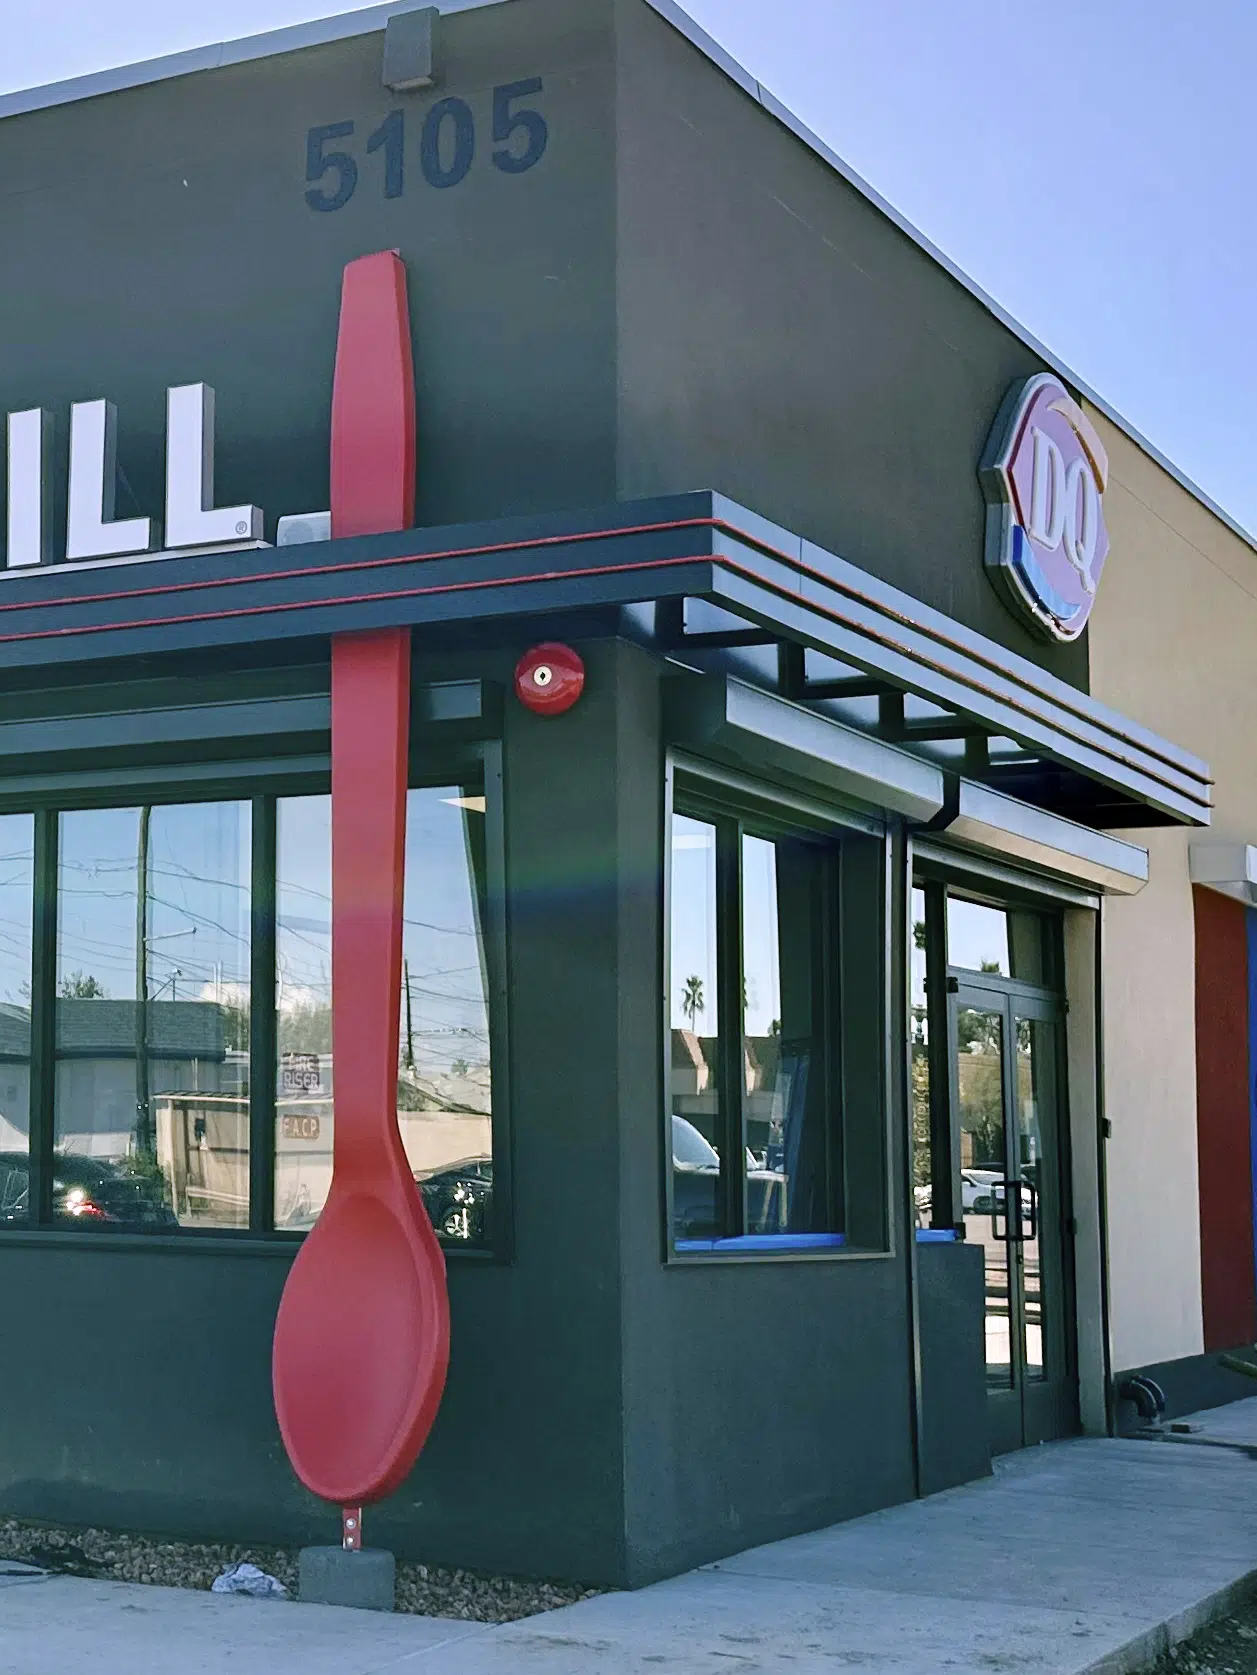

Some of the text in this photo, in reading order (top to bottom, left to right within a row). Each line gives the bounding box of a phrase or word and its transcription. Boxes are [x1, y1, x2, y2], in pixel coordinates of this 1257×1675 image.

[304, 76, 548, 212] 5105
[1030, 425, 1098, 595] DQ
[284, 1071, 319, 1089] RISER
